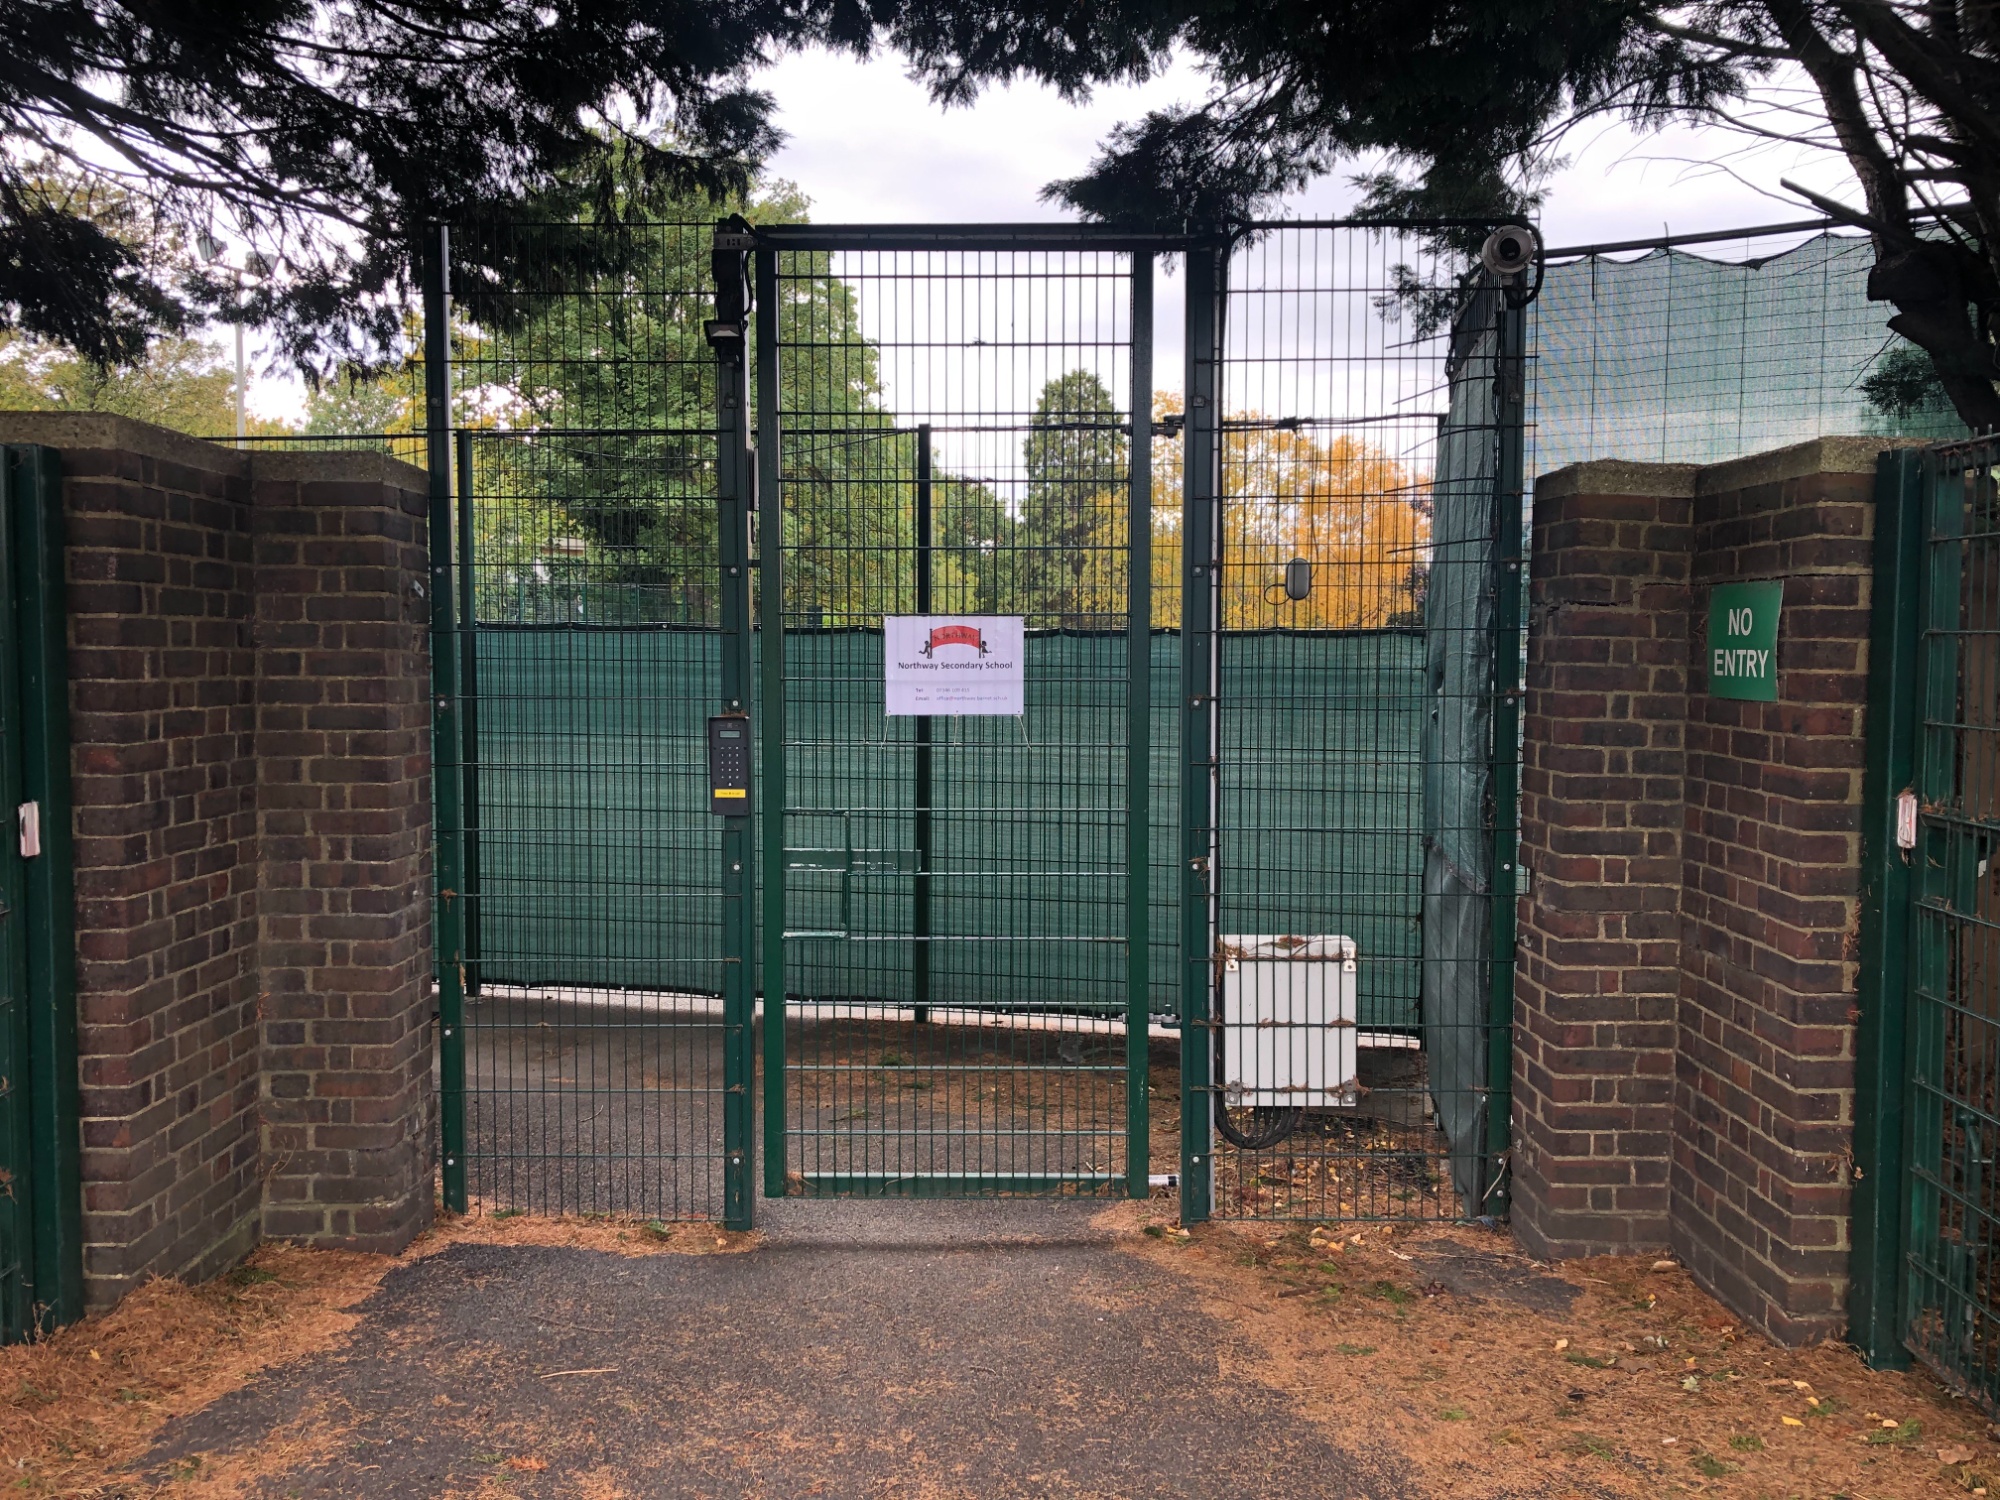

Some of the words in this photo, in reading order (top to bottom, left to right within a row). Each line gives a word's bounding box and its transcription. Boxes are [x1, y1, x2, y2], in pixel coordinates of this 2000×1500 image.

[1728, 607, 1753, 636] NO
[898, 661, 938, 671] Northway
[941, 661, 983, 671] Secondary
[985, 661, 1013, 670] School
[1714, 649, 1769, 678] ENTRY
